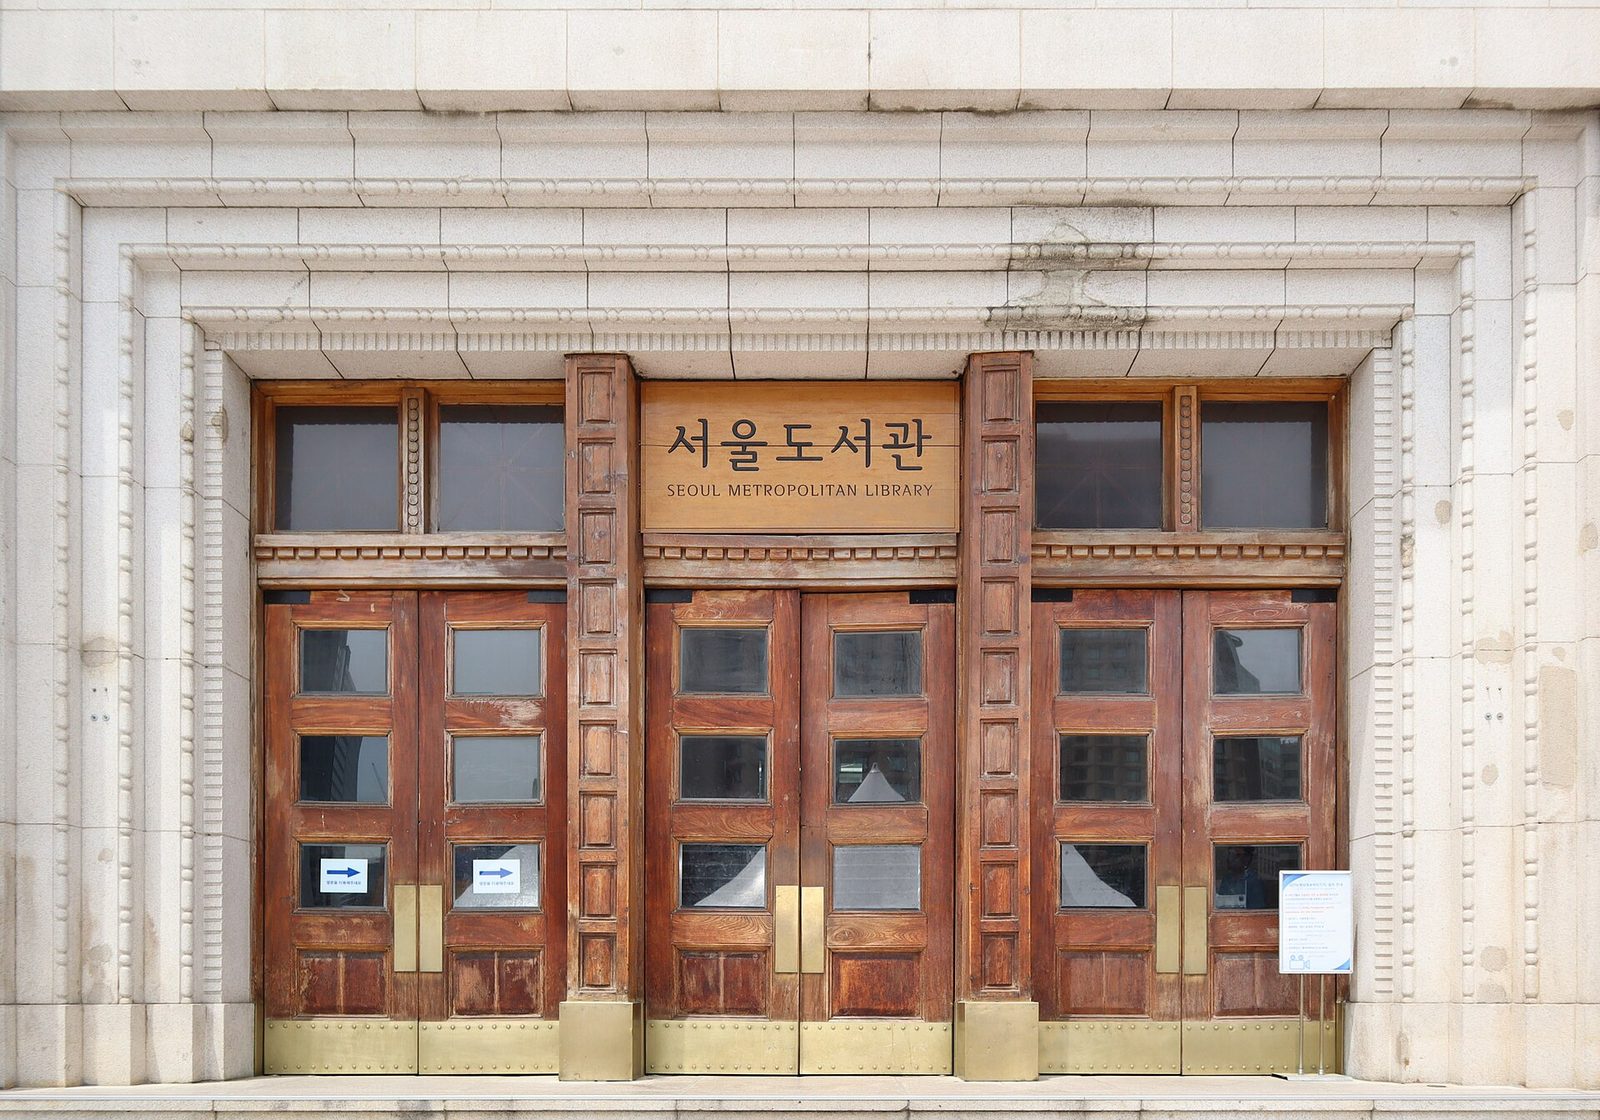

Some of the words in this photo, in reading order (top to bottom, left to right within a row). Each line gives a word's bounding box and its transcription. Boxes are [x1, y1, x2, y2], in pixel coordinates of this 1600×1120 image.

[667, 418, 933, 472] 서울도서관
[667, 484, 721, 497] SEOUL
[728, 484, 858, 497] METROPOLITAN
[865, 484, 933, 497] LIBRARY
